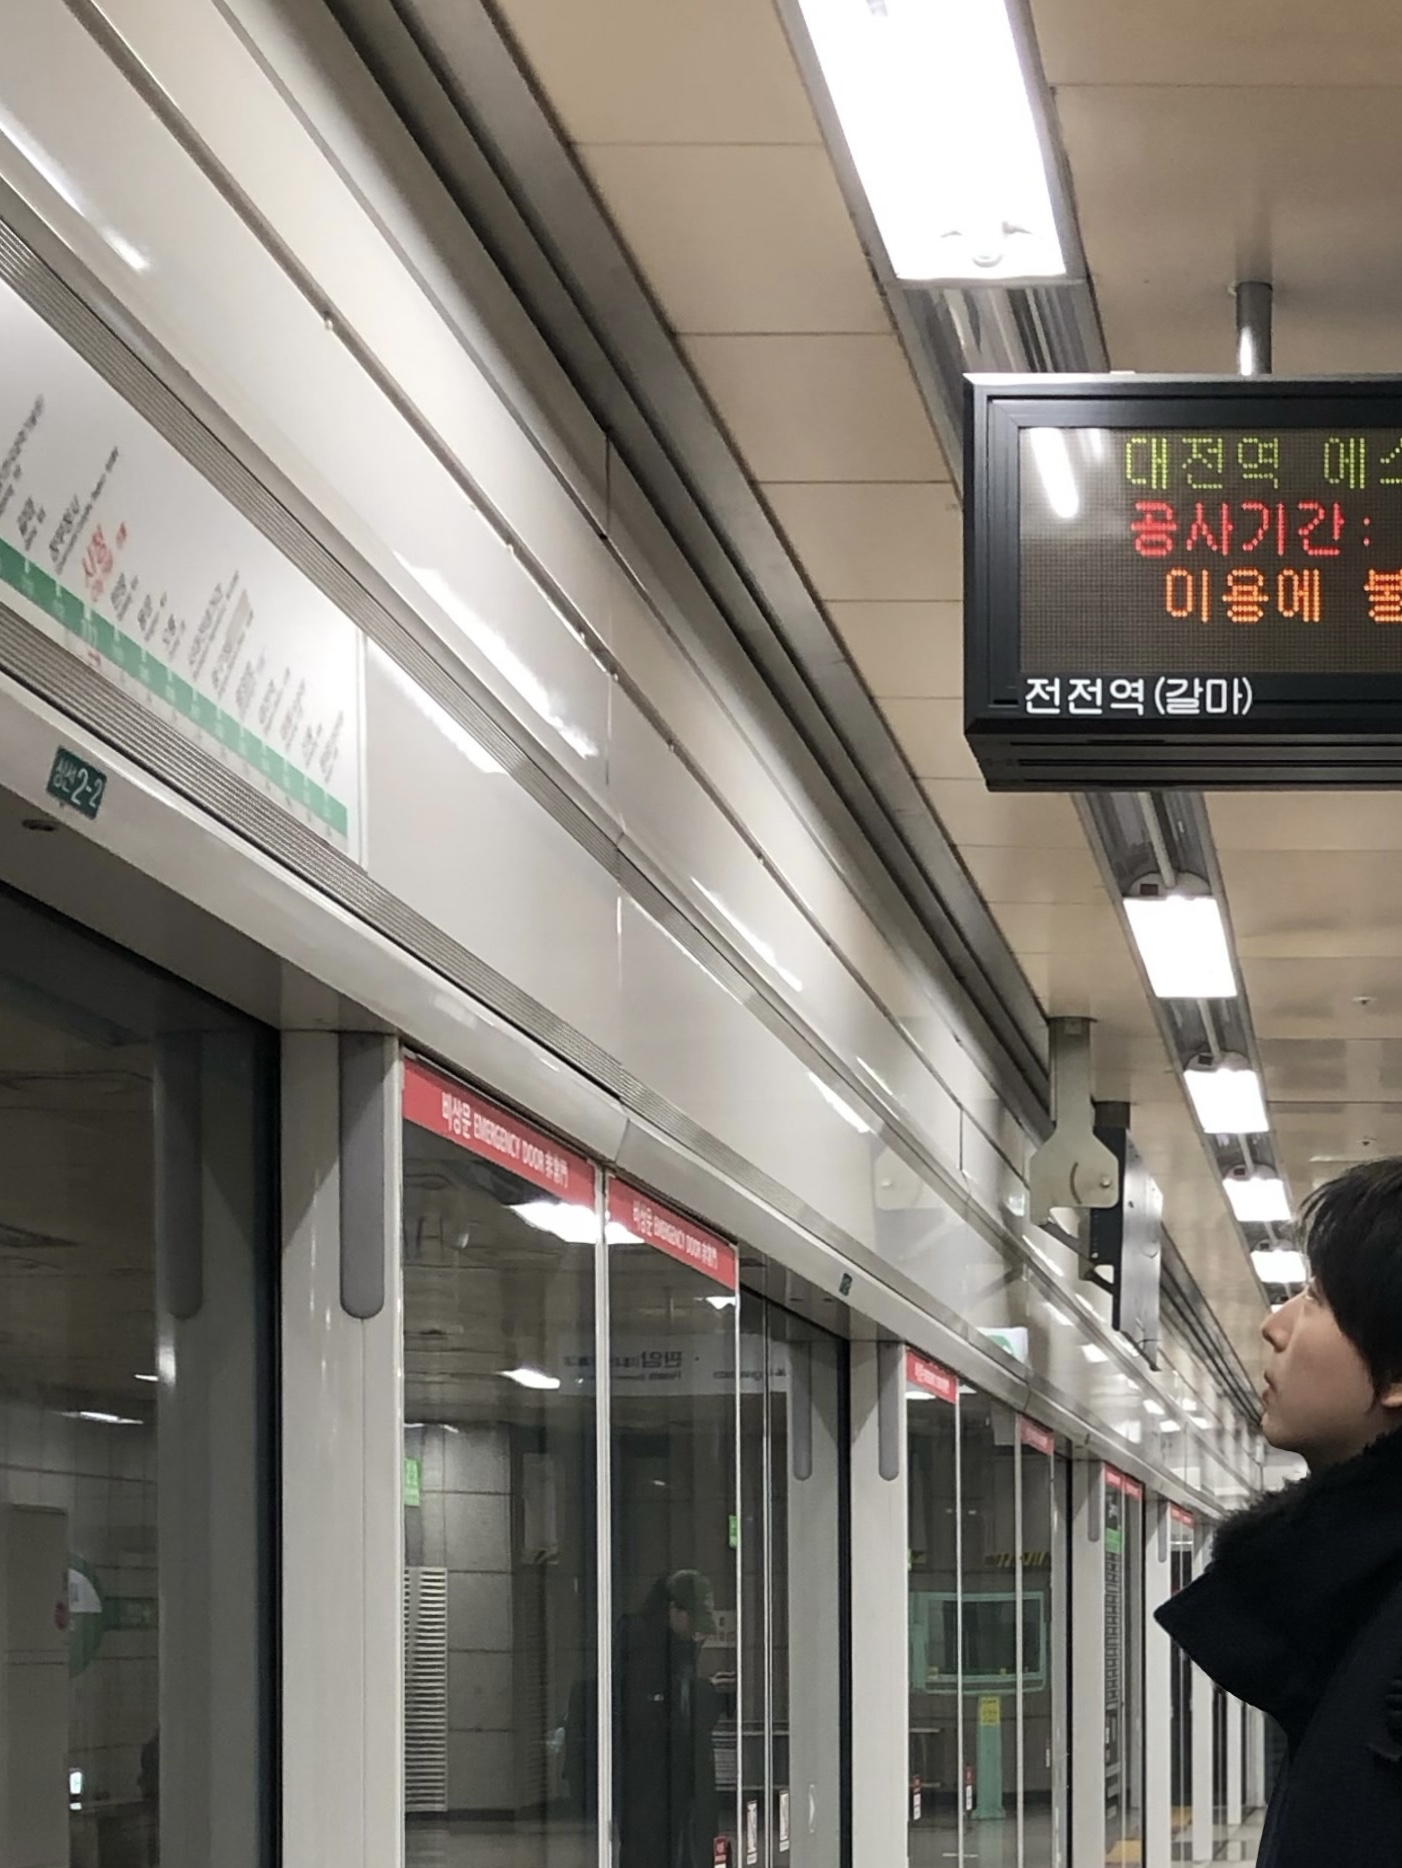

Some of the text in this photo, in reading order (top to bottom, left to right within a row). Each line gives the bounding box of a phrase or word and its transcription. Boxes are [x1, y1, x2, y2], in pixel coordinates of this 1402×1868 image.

[1125, 437, 1279, 489] 대전역
[1131, 502, 1371, 556] 공사기간:
[1165, 568, 1321, 624] 이용에
[1024, 676, 1254, 716] 전전역(갈마)
[441, 1091, 472, 1139] 비상문
[473, 1111, 521, 1160] EMERGENCY
[521, 1139, 545, 1174] DOOR
